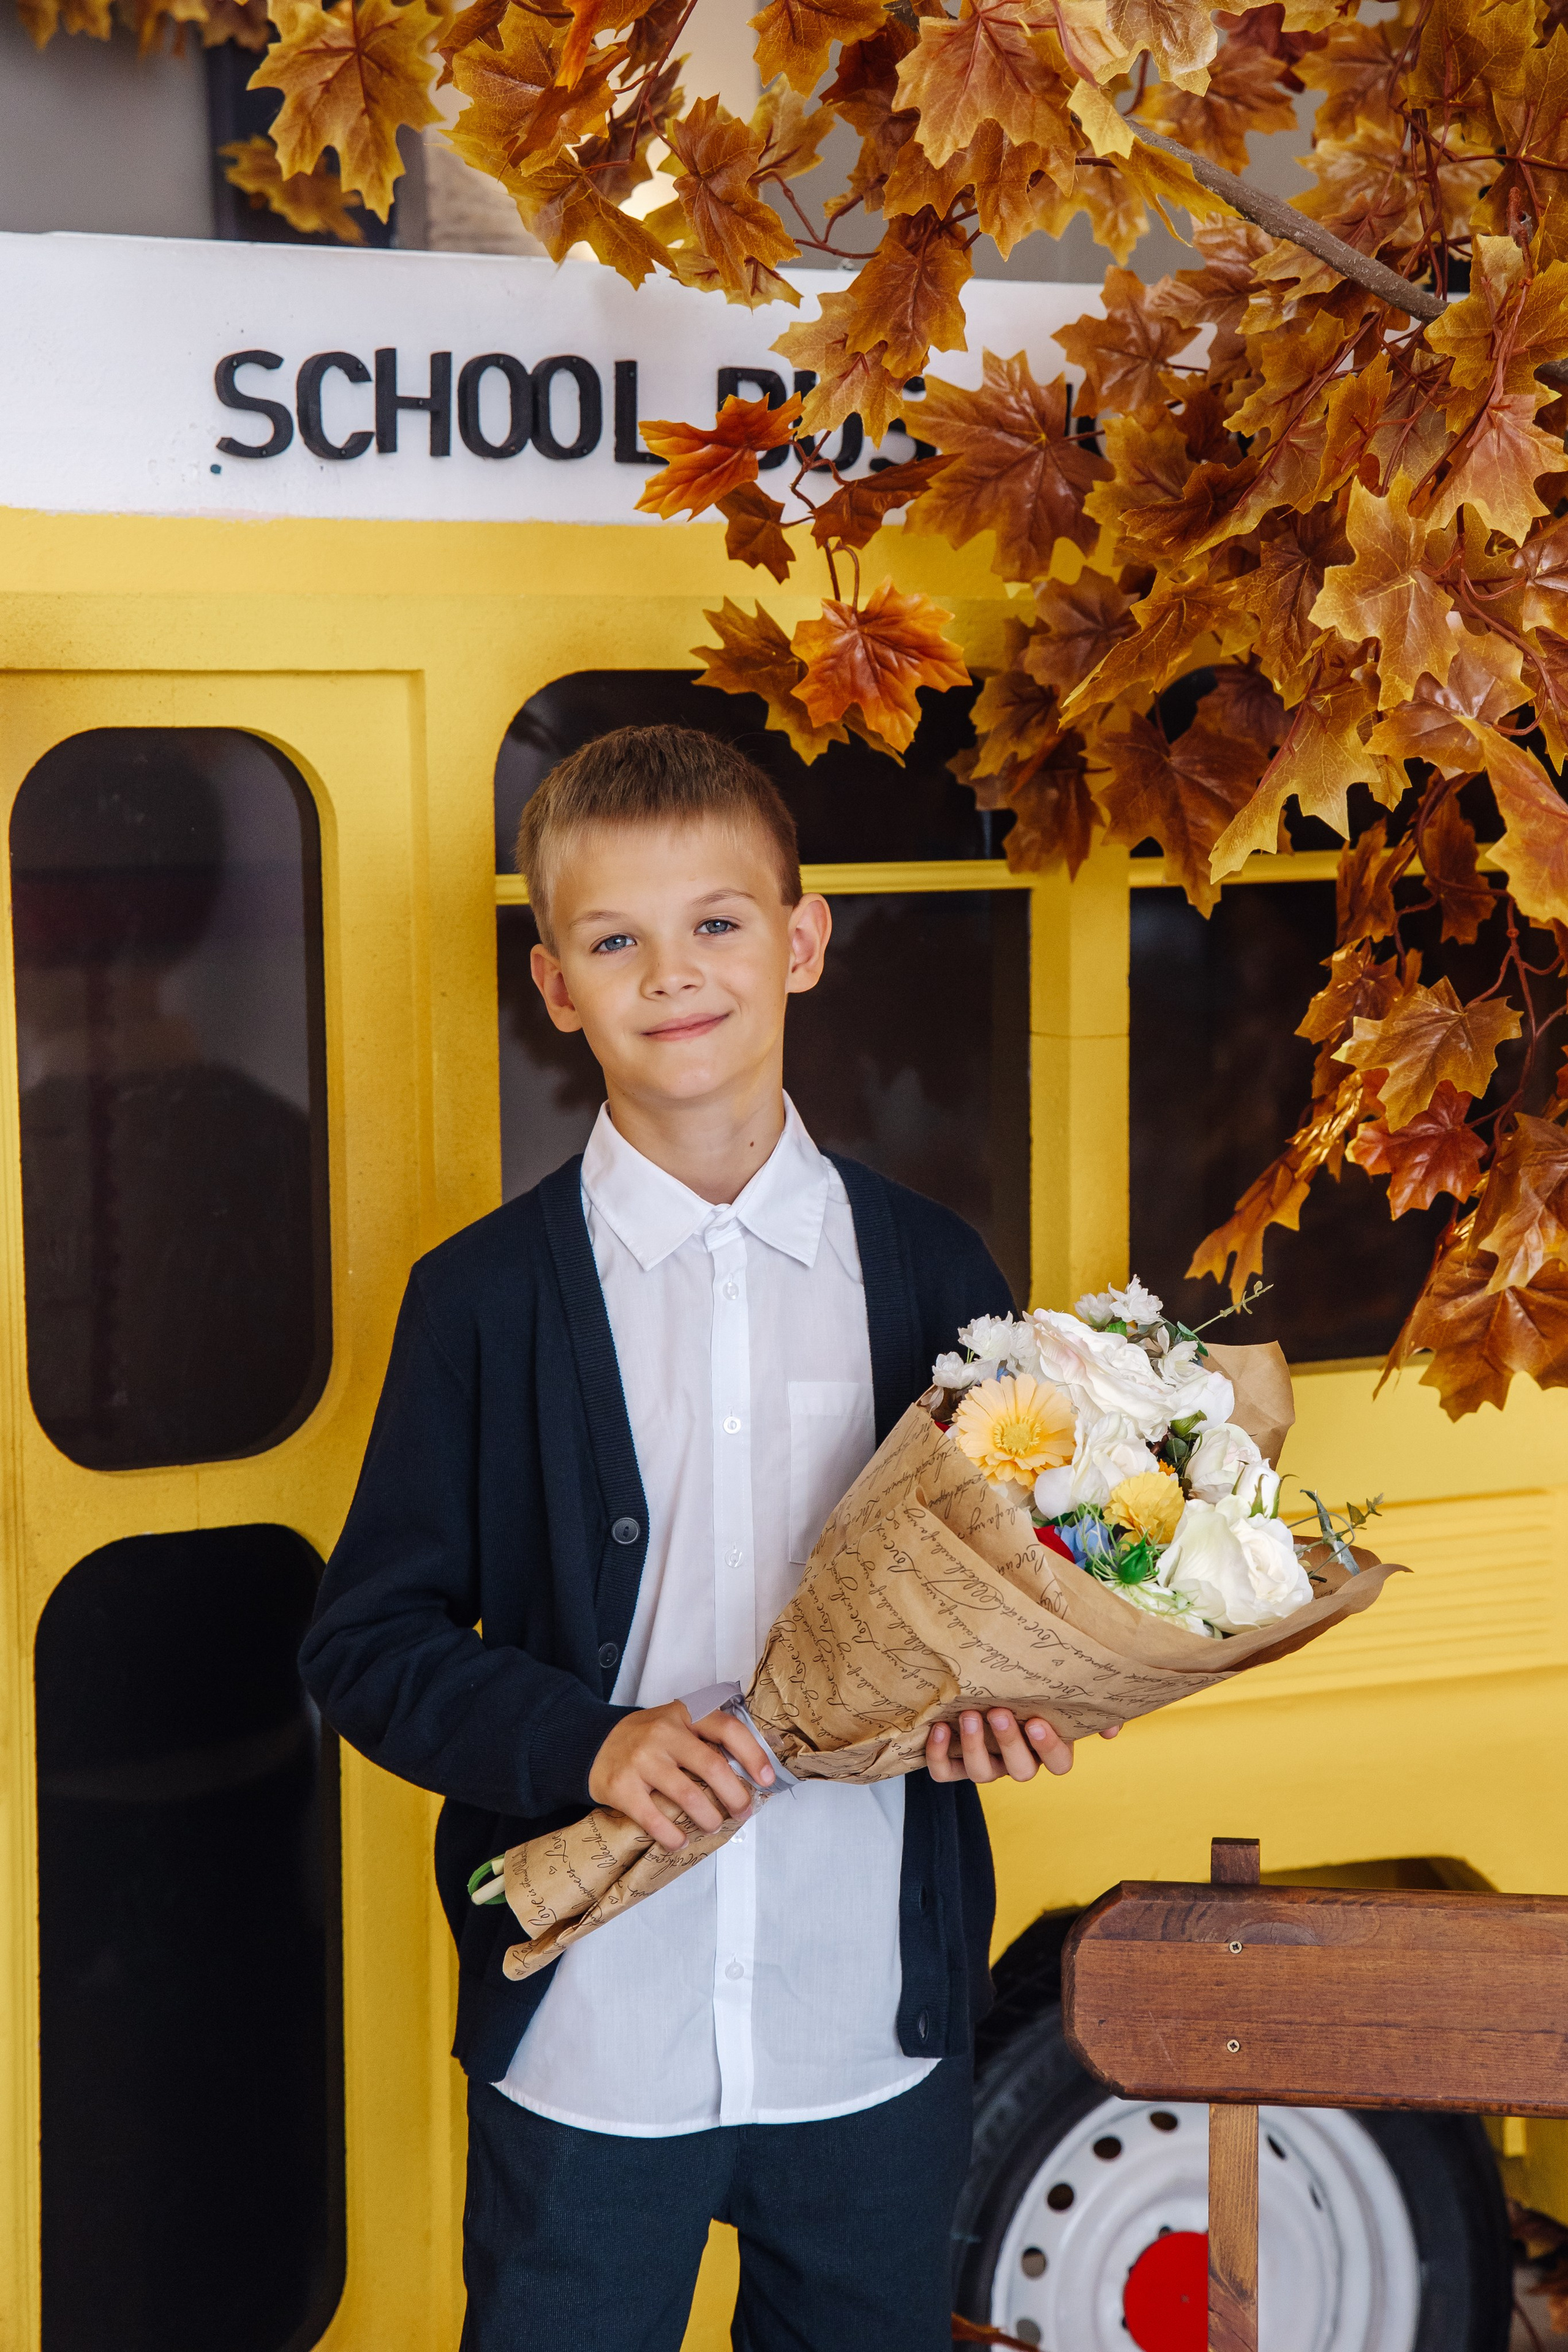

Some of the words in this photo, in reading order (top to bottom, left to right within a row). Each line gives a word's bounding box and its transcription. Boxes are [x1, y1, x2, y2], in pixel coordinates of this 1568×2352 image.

[214, 347, 669, 466] SCHOOL
[883, 1540, 923, 1580] Love
[816, 1602, 837, 1640] Love
[850, 1613, 880, 1648] Love
[1016, 1615, 1028, 1626] is
[1023, 1621, 1071, 1650] Love
[903, 1627, 928, 1652] like
[788, 1650, 805, 1691] Love
[979, 1645, 1010, 1669] like
[1070, 1646, 1122, 1681] happiness
[825, 1672, 852, 1713] Love
[1048, 1681, 1095, 1700] Love
[543, 1832, 568, 1863] Love
[590, 1844, 618, 1869] like
[527, 1888, 537, 1898] is
[567, 1860, 597, 1910] happiness
[527, 1896, 557, 1926] Love
